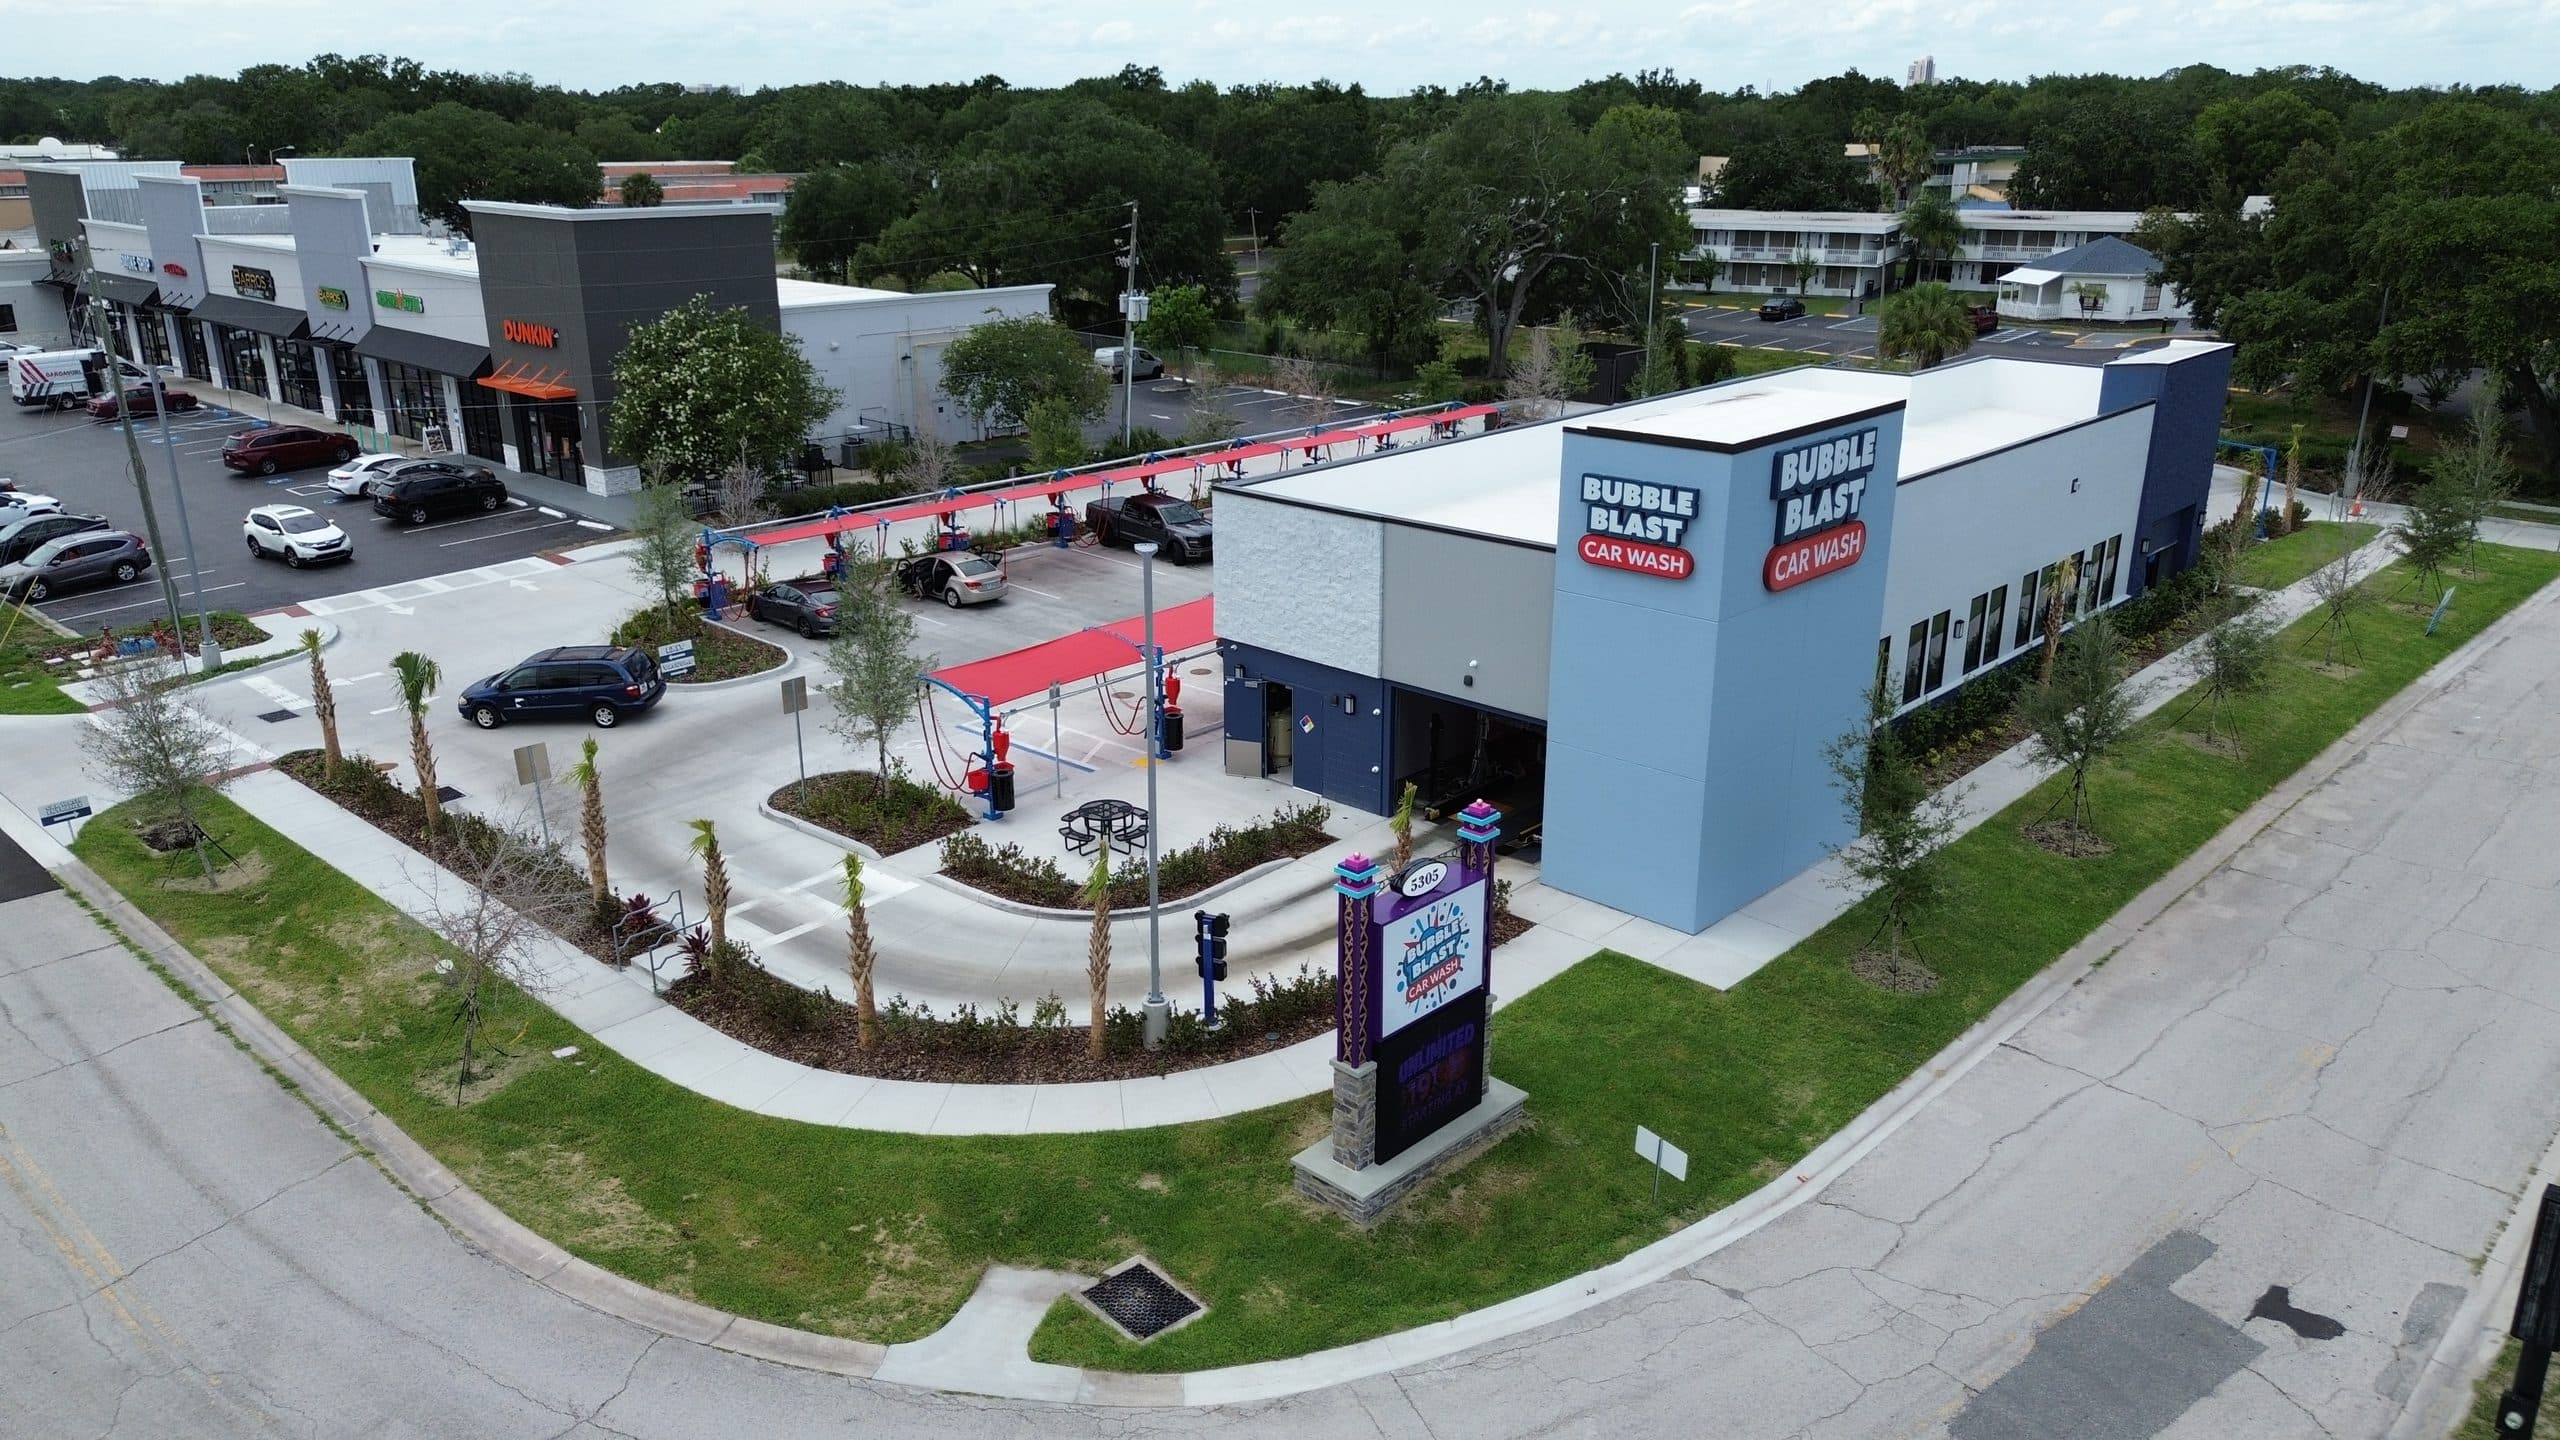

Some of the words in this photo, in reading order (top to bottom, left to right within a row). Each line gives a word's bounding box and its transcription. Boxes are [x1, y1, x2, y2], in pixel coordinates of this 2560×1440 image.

[233, 268, 267, 289] BARROS
[1780, 430, 1876, 491] BUBBLE
[1583, 477, 1693, 516] BUBBLE
[1784, 477, 1866, 536] BLAST
[1590, 507, 1683, 543] BLAST
[1584, 541, 1622, 562] CAR
[1626, 547, 1684, 573] WASH
[1775, 548, 1810, 581] CAR
[1814, 530, 1861, 568] WASH
[1410, 868, 1439, 892] 5305
[1407, 919, 1460, 963] BUBBLE
[1412, 939, 1456, 979] BLAST
[1408, 978, 1429, 998] CAR
[1431, 959, 1458, 984] WASH
